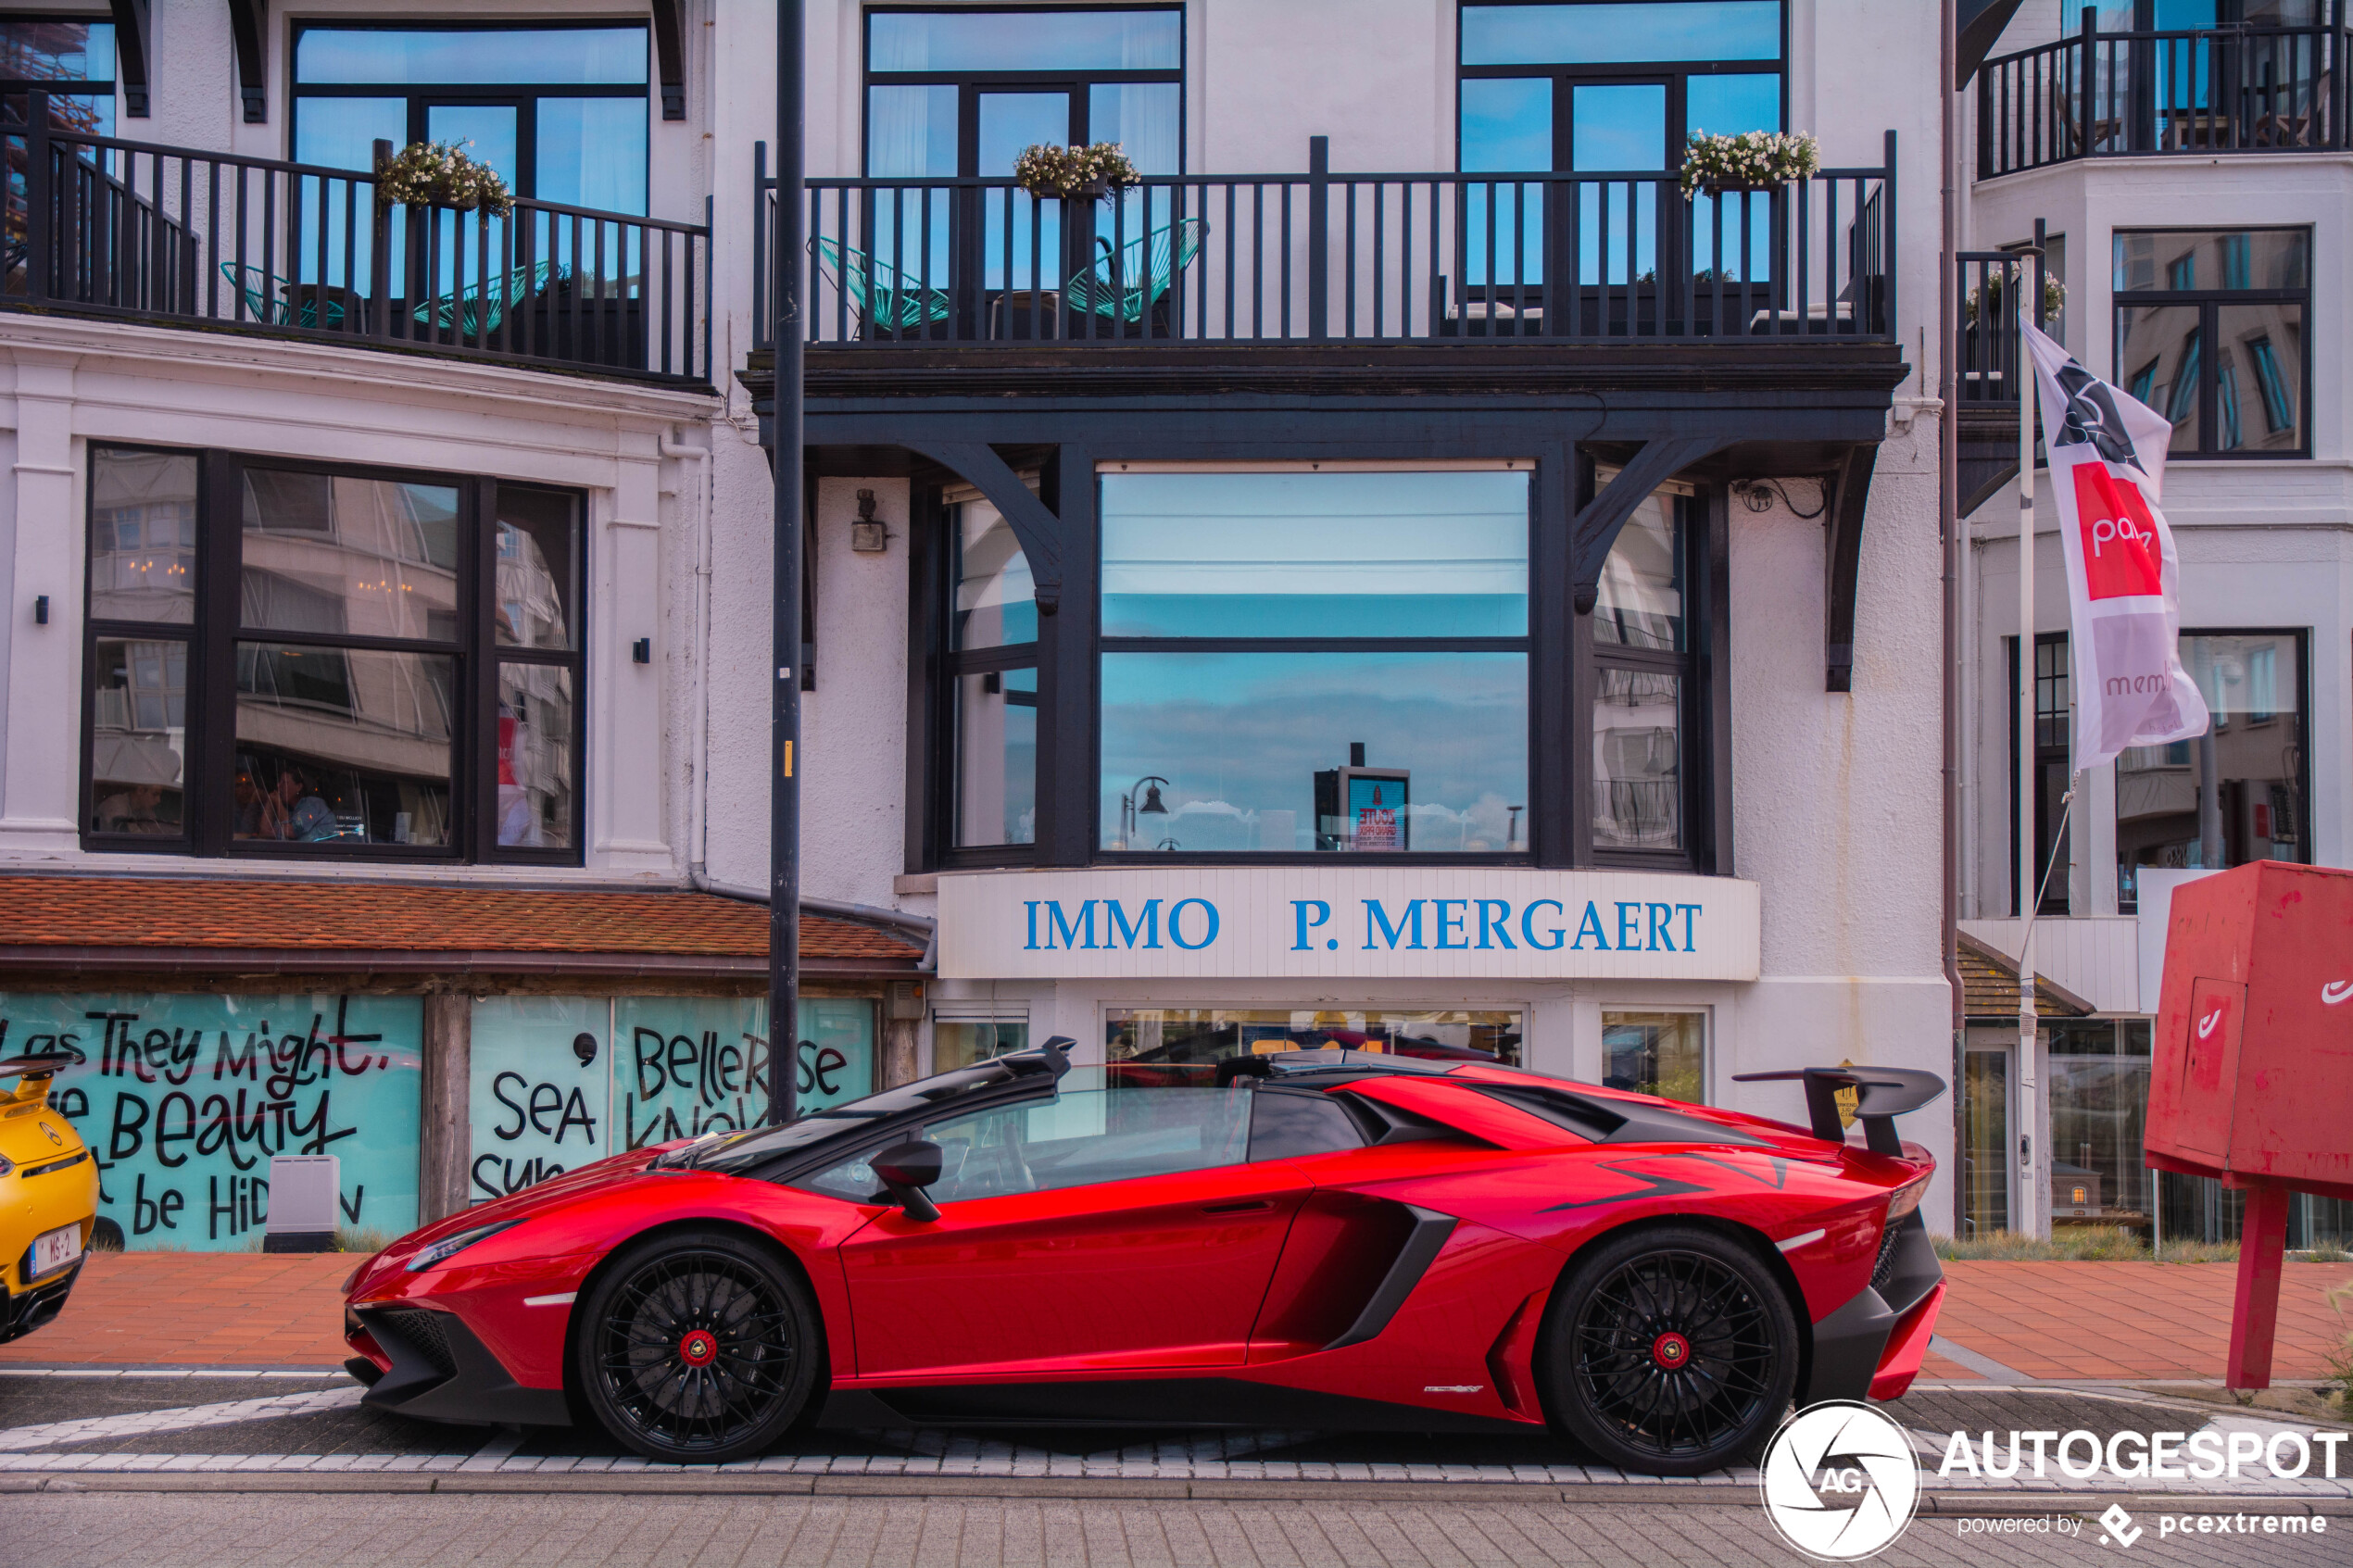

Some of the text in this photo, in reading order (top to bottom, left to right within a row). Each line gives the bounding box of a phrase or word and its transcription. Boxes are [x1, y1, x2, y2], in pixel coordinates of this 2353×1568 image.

[1023, 898, 1703, 953] IMMO P. MERGAERT
[85, 1011, 203, 1085] They
[133, 1173, 184, 1236] be
